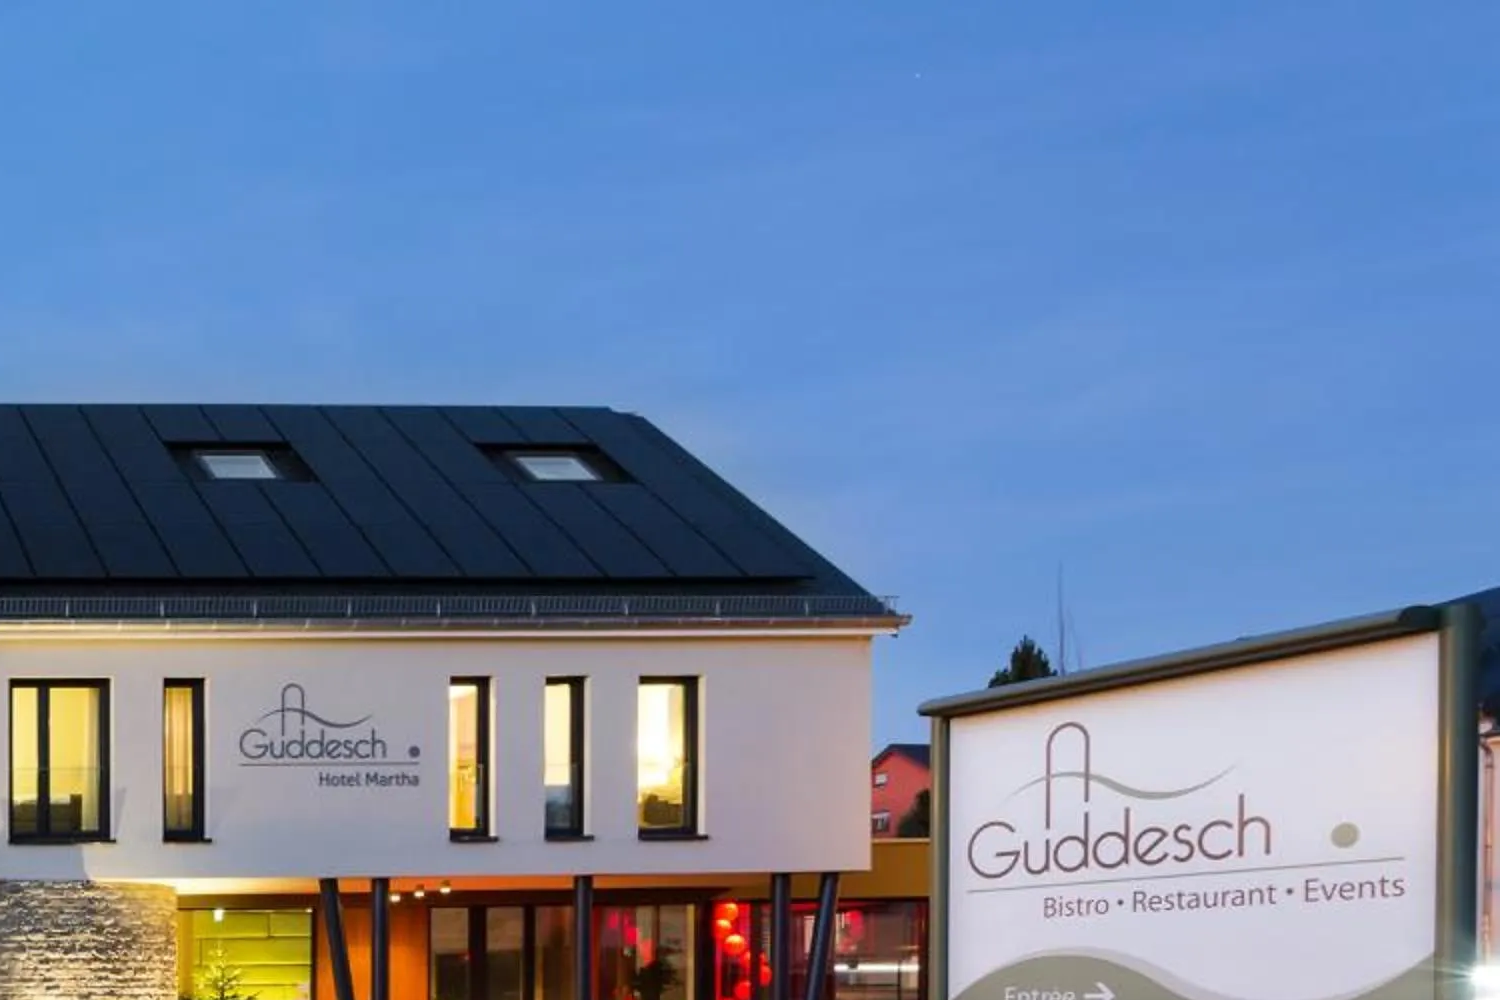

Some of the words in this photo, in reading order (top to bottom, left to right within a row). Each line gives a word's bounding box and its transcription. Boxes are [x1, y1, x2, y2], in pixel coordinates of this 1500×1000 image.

[239, 728, 387, 759] Guddesch
[319, 772, 361, 786] Hotel
[366, 772, 419, 786] Martha
[967, 794, 1271, 879] Guddesch
[1043, 896, 1109, 918] Bistro
[1132, 885, 1277, 912] Restaurant
[1304, 876, 1405, 903] Events
